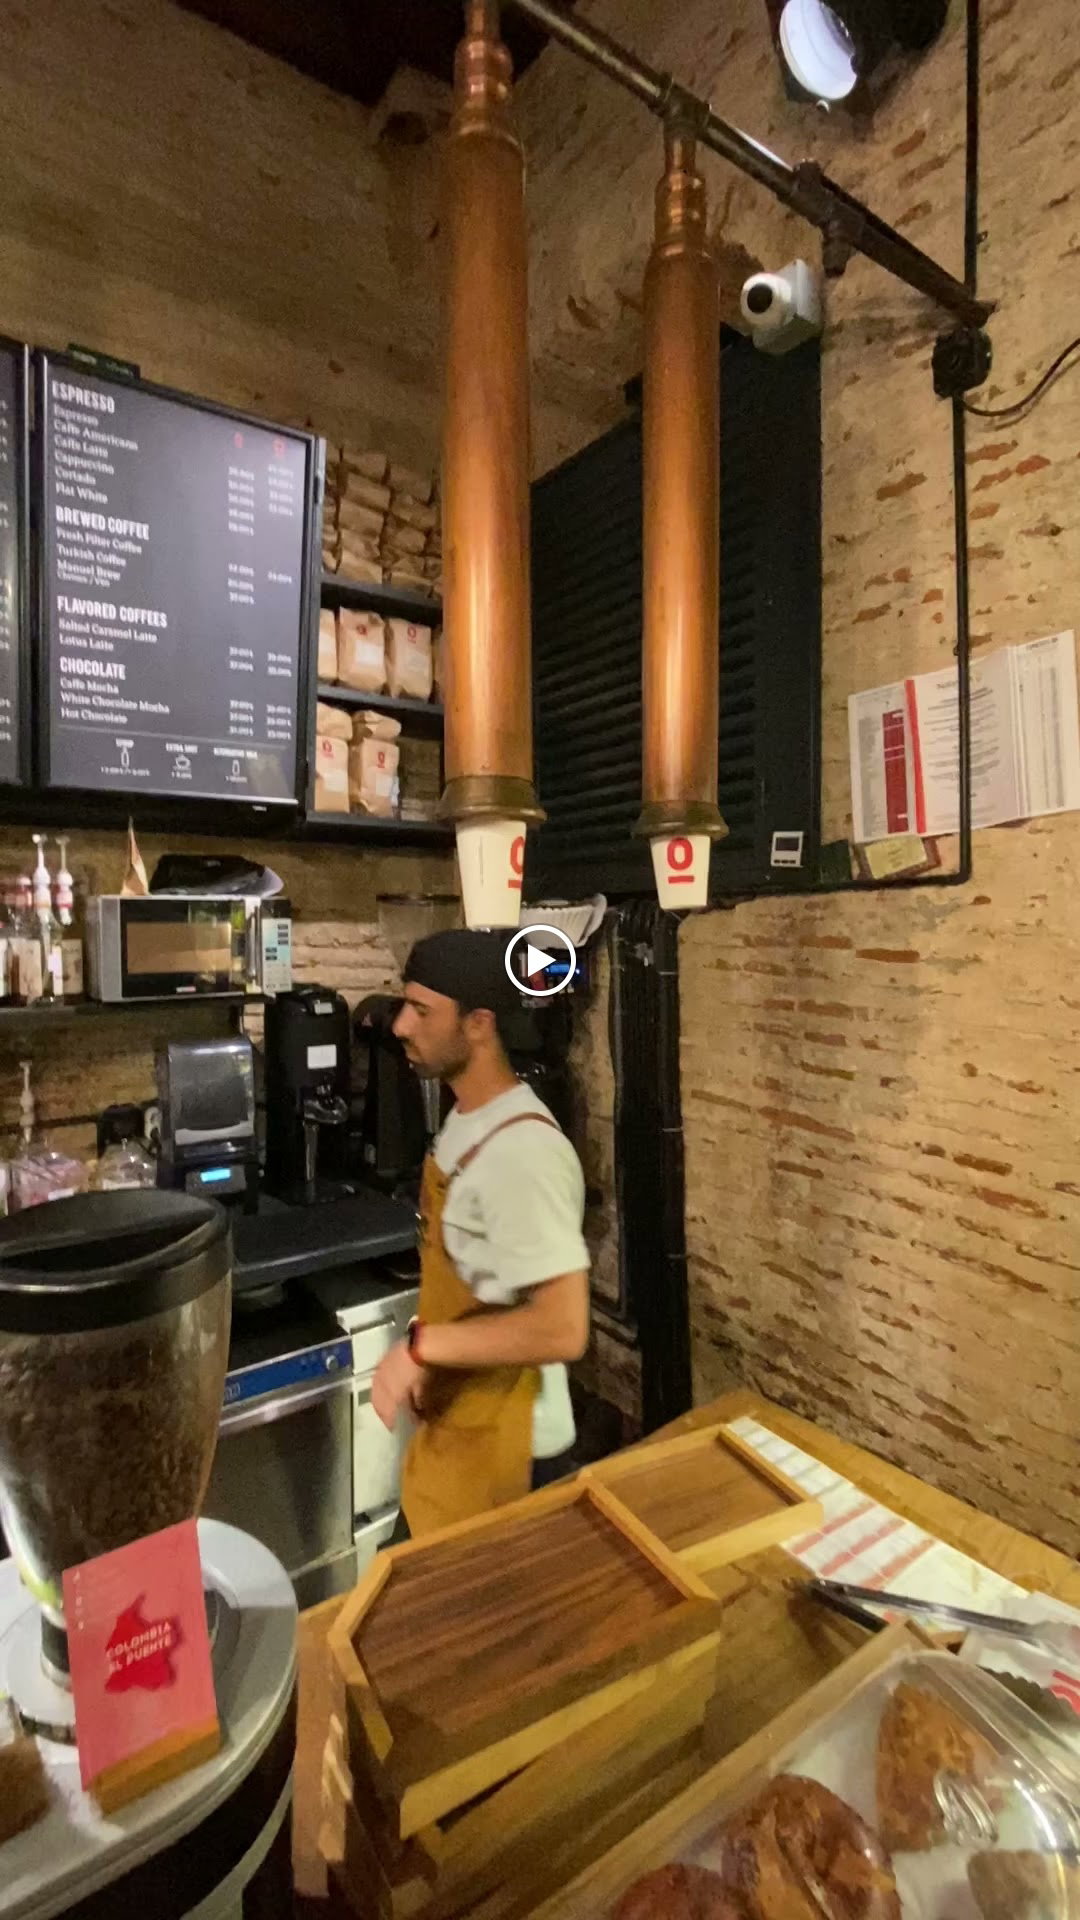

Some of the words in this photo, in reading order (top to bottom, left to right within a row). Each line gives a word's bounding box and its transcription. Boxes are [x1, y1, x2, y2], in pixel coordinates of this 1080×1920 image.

[52, 380, 115, 414] ESPRESSO
[54, 403, 99, 426] Espresso
[82, 427, 138, 450] Americano
[82, 441, 108, 459] Latte
[54, 449, 114, 475] Cappuccino
[55, 466, 96, 485] Cortado
[55, 482, 75, 497] Flat
[76, 486, 108, 504] White
[55, 505, 106, 531] BREWED
[107, 516, 149, 541] COFFEE
[56, 526, 84, 542] Fresh
[85, 532, 111, 548] Filter
[112, 538, 142, 554] Coffee
[56, 543, 95, 561] Turkish
[96, 551, 126, 567] Coffee
[96, 565, 121, 581] Brew
[57, 595, 117, 620] FLAVORED
[119, 606, 168, 629] COFFEES
[58, 618, 90, 634] Salted
[91, 623, 132, 641] Caramel
[133, 629, 158, 643] Latte
[59, 633, 88, 649] Lotus
[89, 637, 114, 652] Latte
[59, 656, 126, 681] CHOCOLATE
[87, 680, 119, 695] Mocha
[60, 692, 91, 706] White
[91, 695, 138, 712] Chocolate
[138, 700, 170, 715] Mocha
[61, 707, 79, 719] Hot
[80, 709, 128, 725] Chocolate
[106, 1621, 171, 1659] COLOMBIA
[125, 1633, 171, 1667] PUENTE
